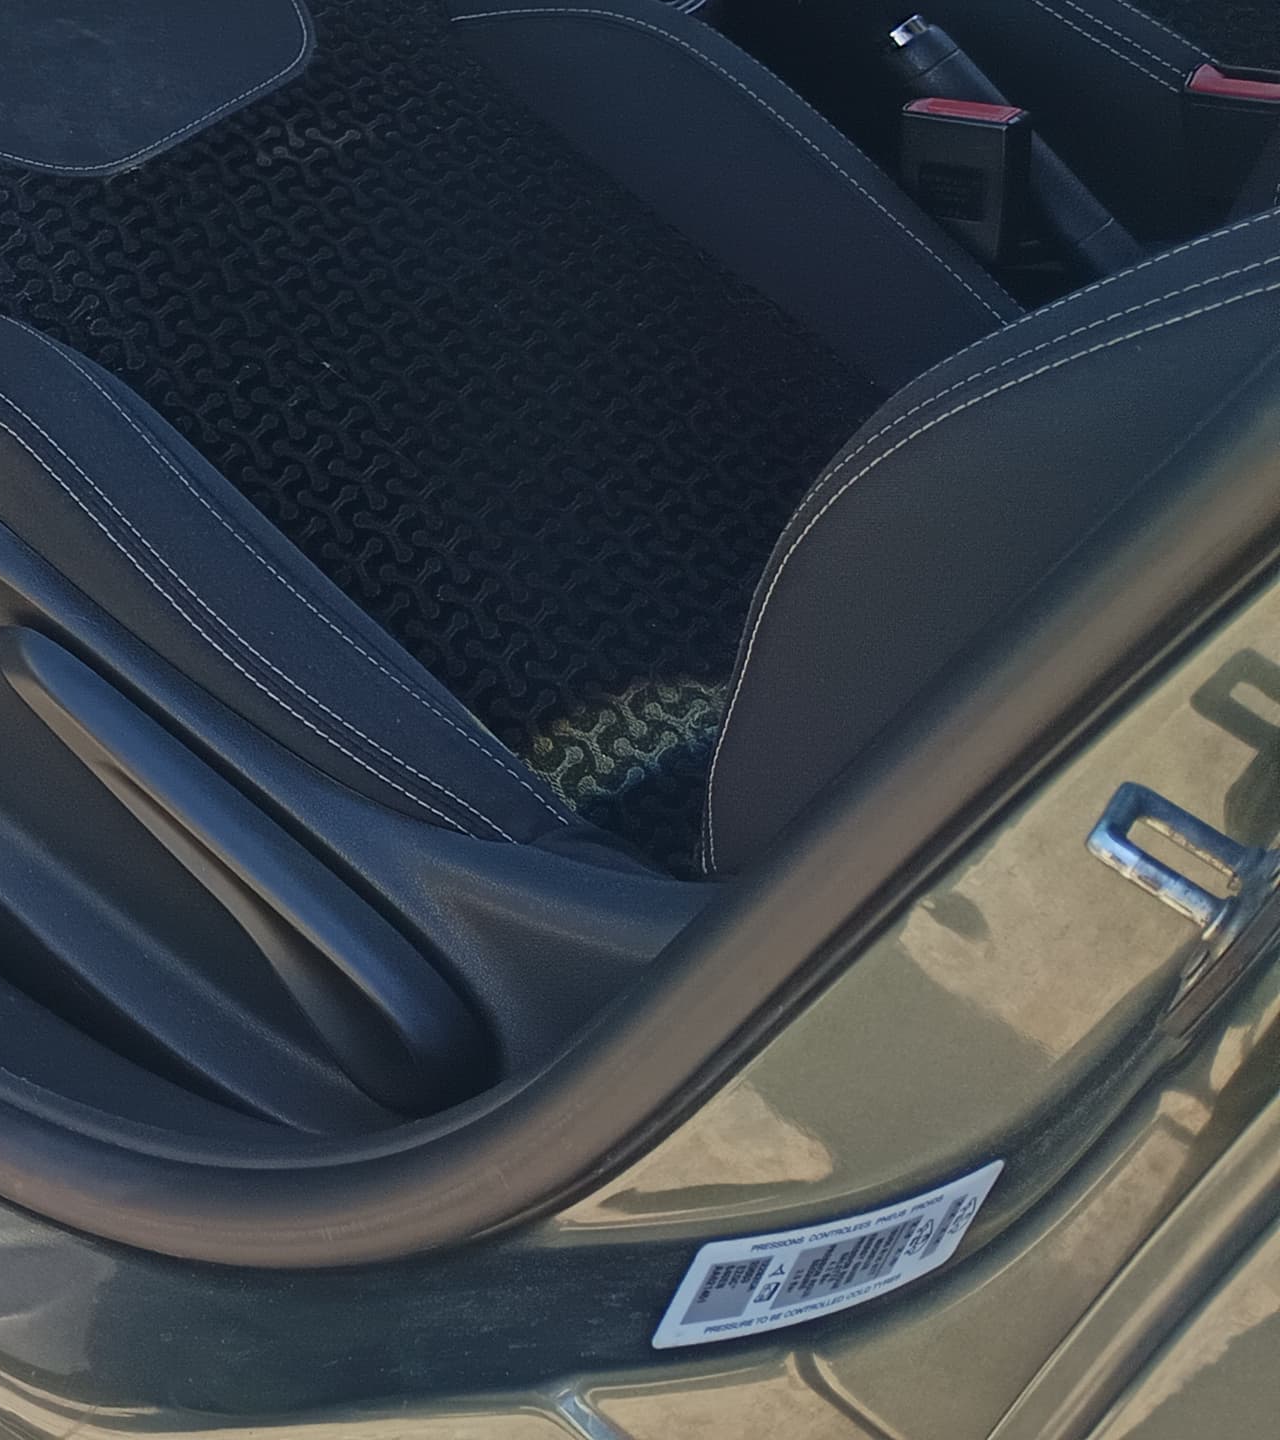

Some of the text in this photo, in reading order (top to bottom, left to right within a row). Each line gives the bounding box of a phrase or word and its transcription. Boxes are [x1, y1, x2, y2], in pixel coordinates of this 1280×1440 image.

[704, 1318, 755, 1334] PRESSURE
[756, 1316, 769, 1326] TO
[769, 1312, 782, 1322] BE
[784, 1294, 844, 1318] CONTROLLED
